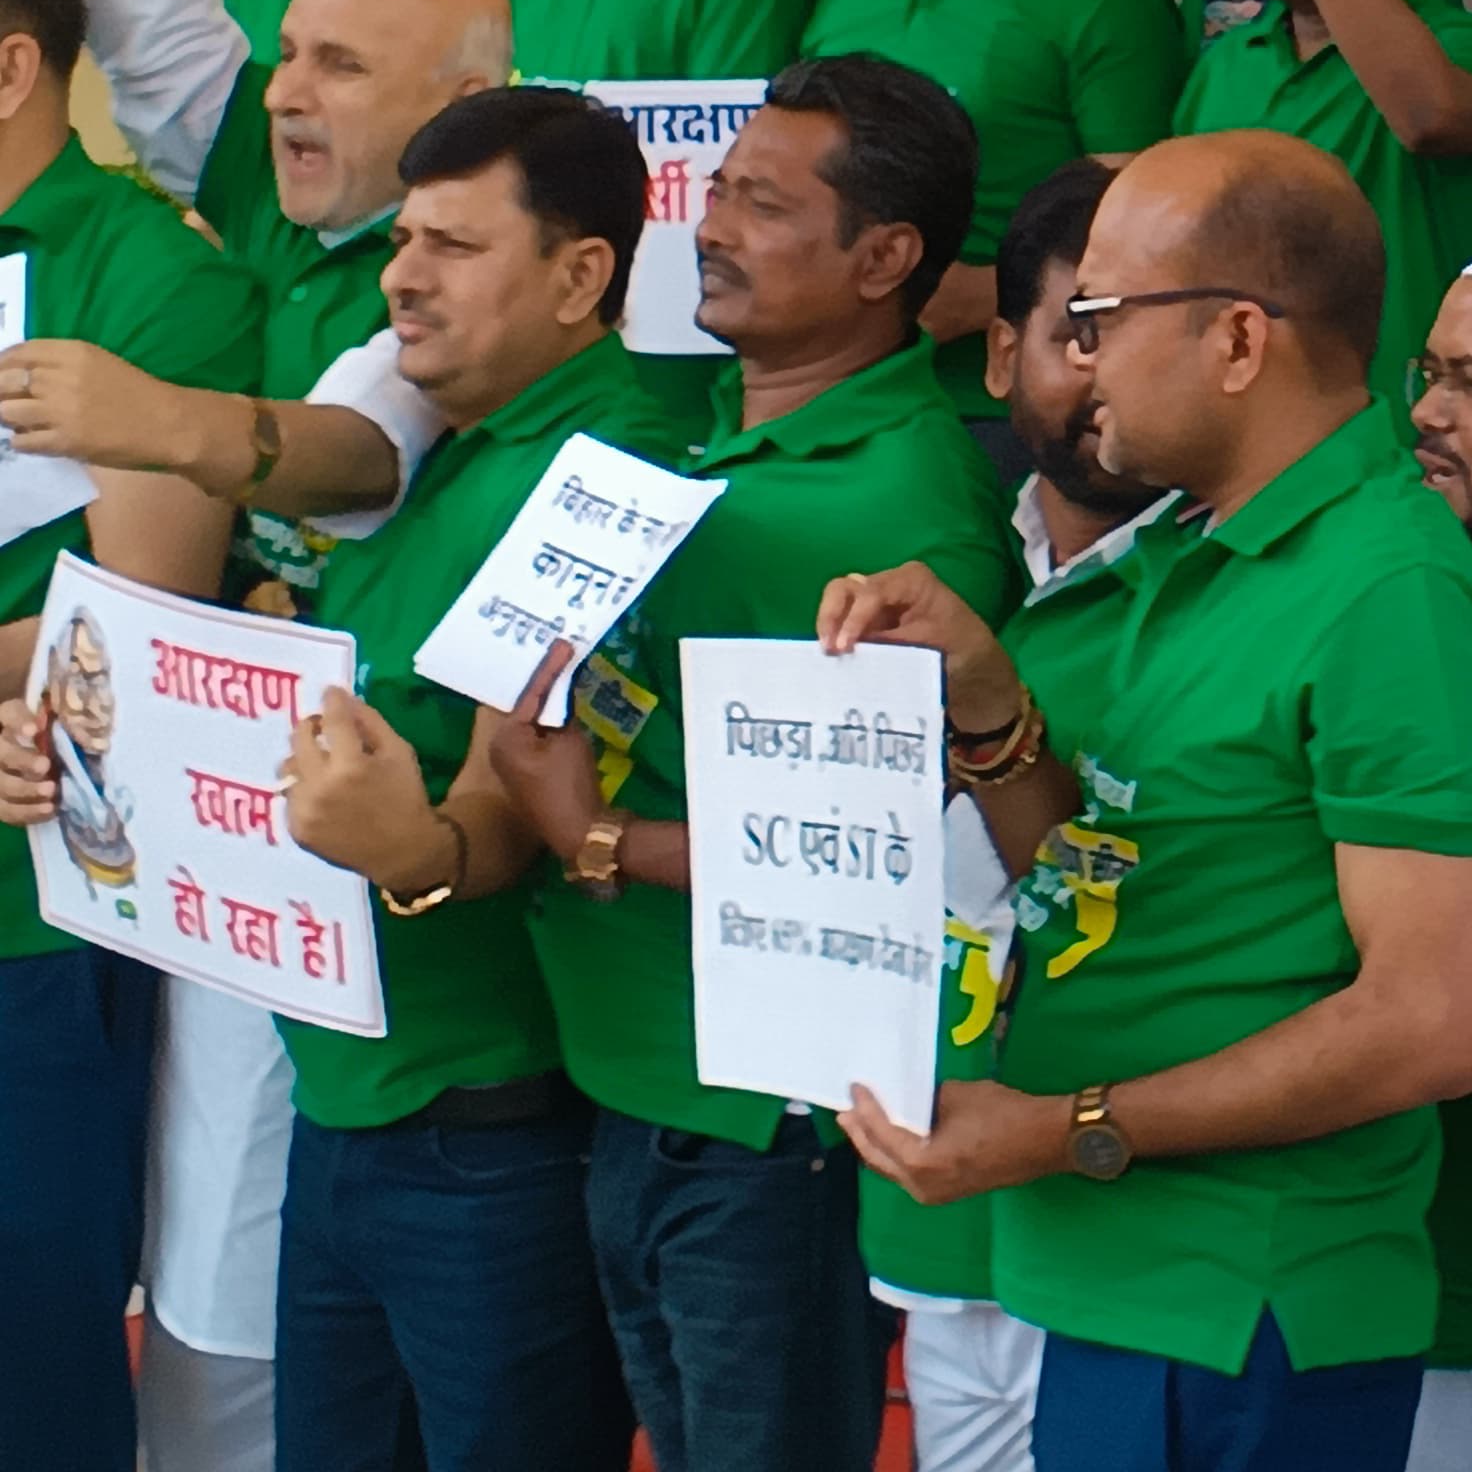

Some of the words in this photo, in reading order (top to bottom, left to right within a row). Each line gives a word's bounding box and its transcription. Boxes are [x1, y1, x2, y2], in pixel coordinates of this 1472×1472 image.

[150, 637, 302, 727] आरक्षण
[725, 700, 813, 771] पिछड़ा
[185, 767, 281, 846] खत्म
[742, 812, 791, 868] SC
[800, 806, 840, 876] एवं
[168, 865, 210, 943] हो
[221, 895, 281, 966] रहा
